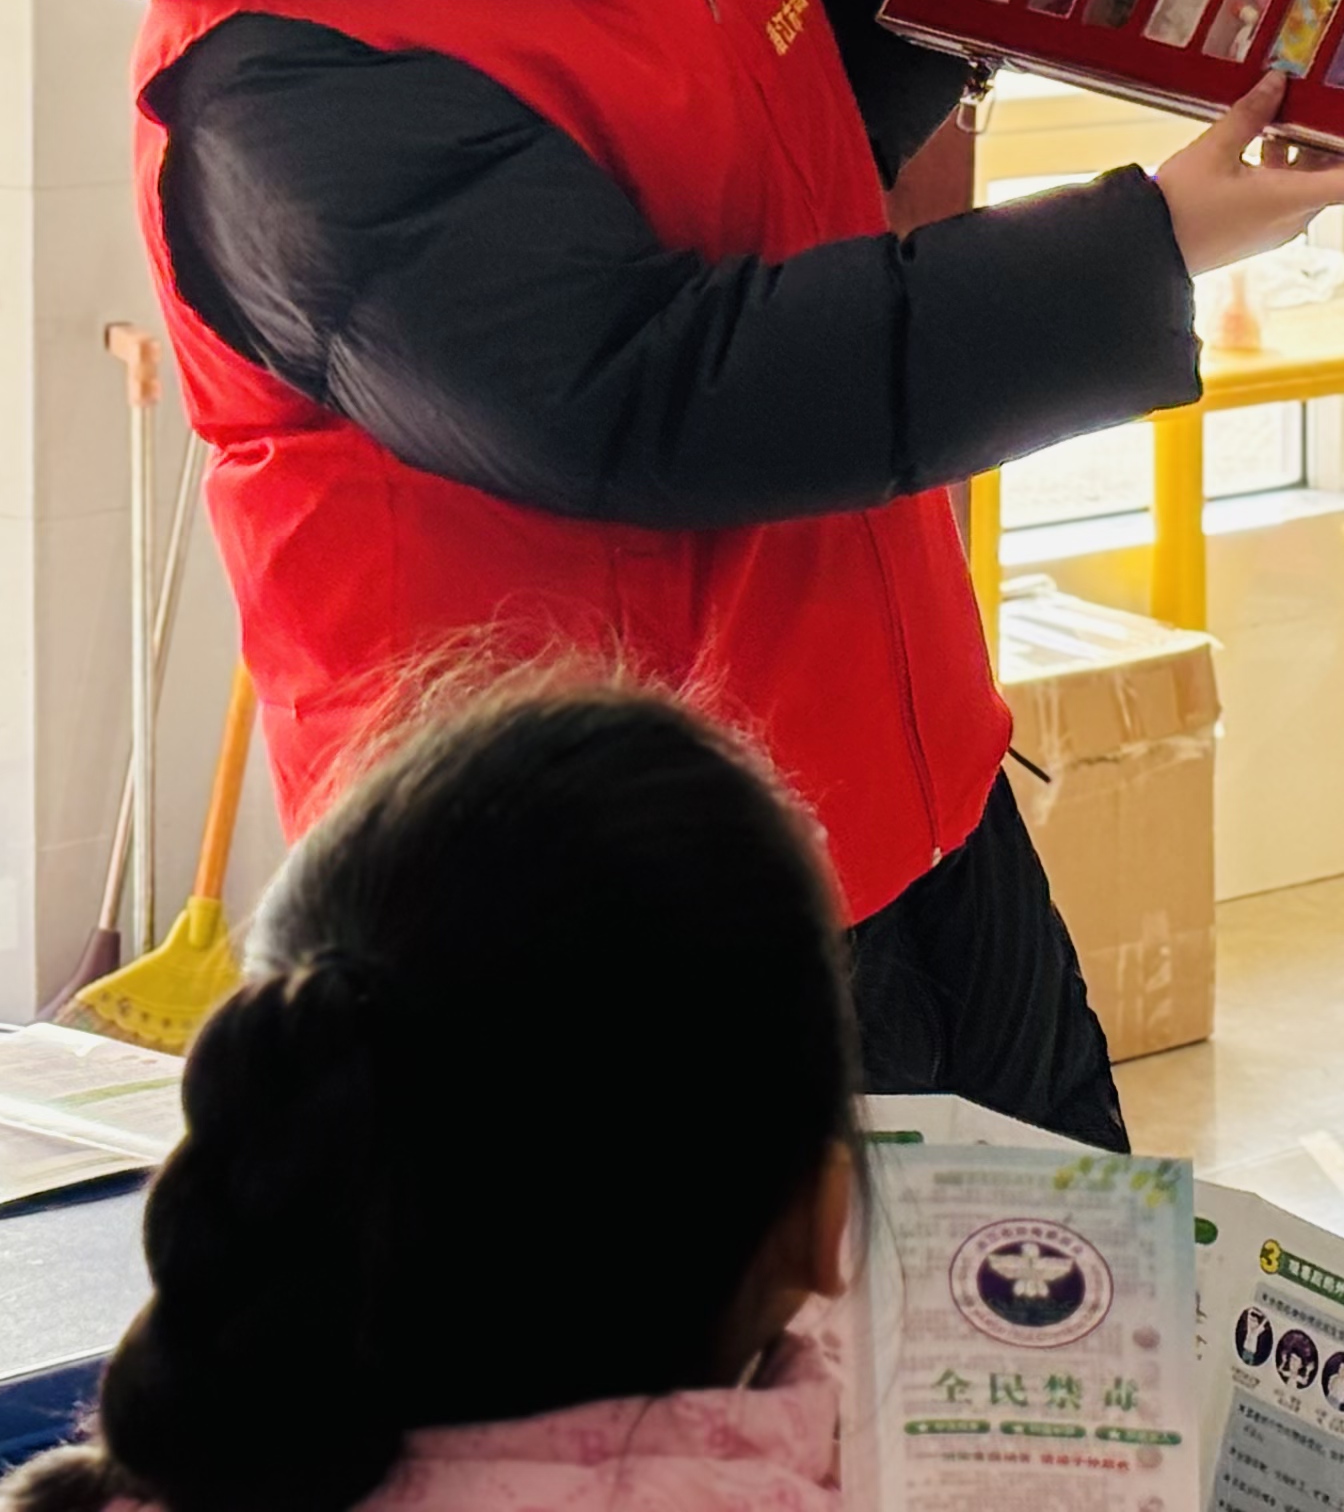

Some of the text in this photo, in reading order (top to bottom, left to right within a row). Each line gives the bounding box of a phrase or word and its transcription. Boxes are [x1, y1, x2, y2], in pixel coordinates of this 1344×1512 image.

[1261, 1239, 1281, 1274] 3
[929, 1367, 1140, 1412] 全民禁毒
